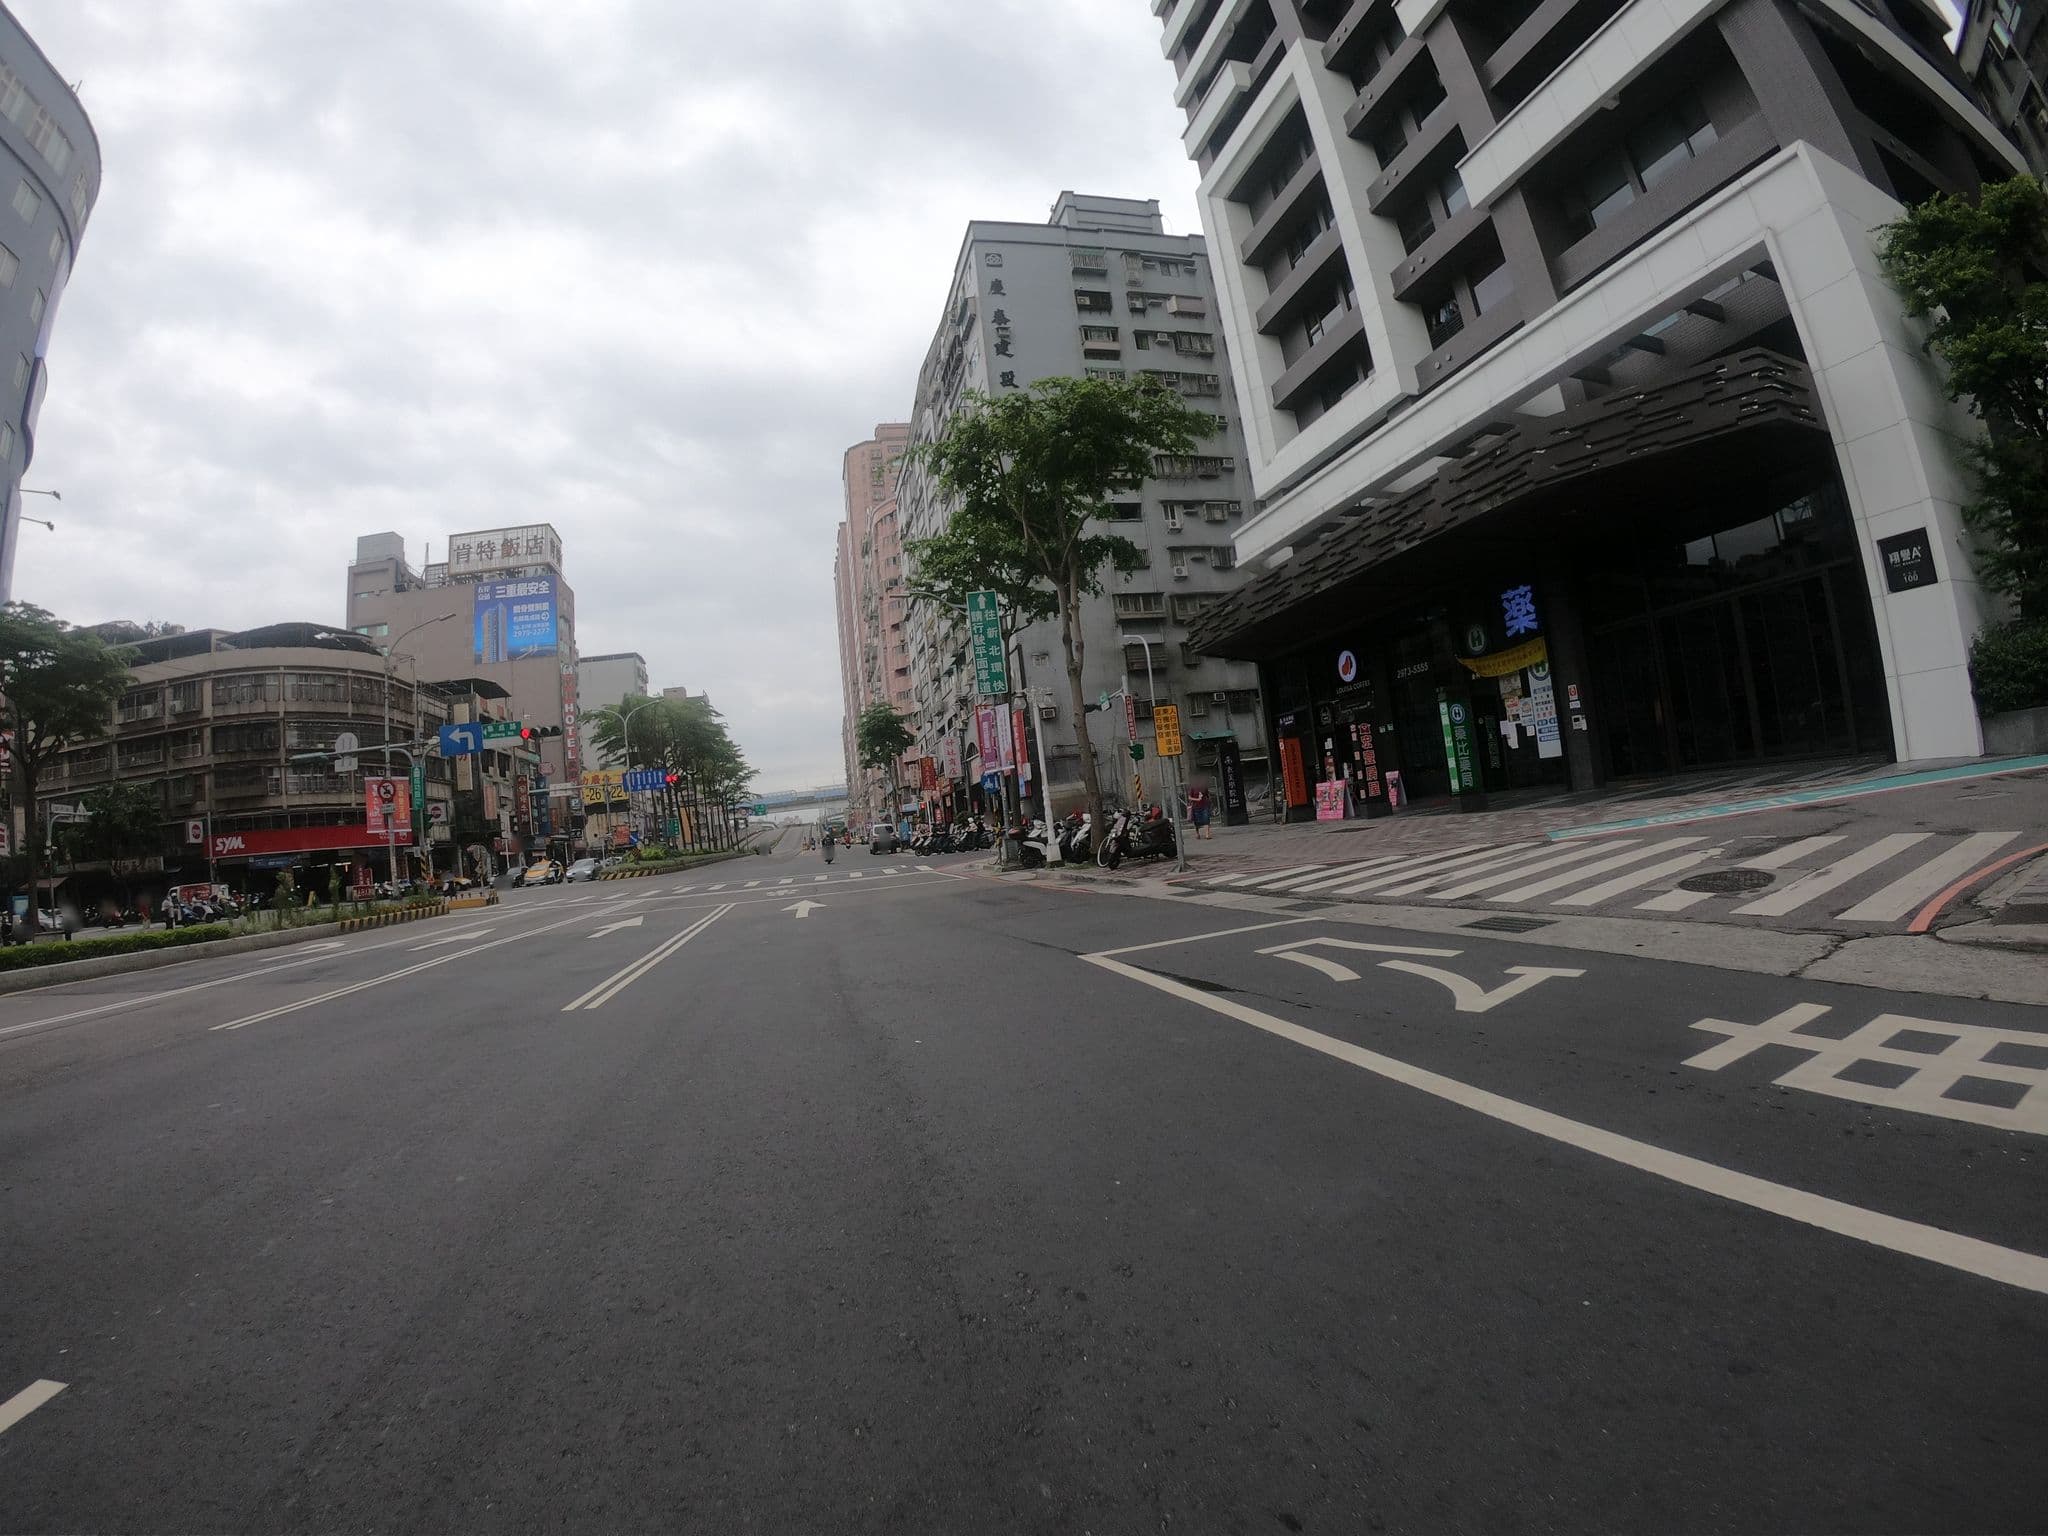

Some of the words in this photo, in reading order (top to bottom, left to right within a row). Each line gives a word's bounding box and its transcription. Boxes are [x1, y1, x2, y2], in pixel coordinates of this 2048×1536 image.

[453, 534, 544, 564] 肯特飯店
[495, 580, 550, 599] 三重最安全
[564, 703, 577, 760] HOTEL
[215, 836, 245, 854] SYM
